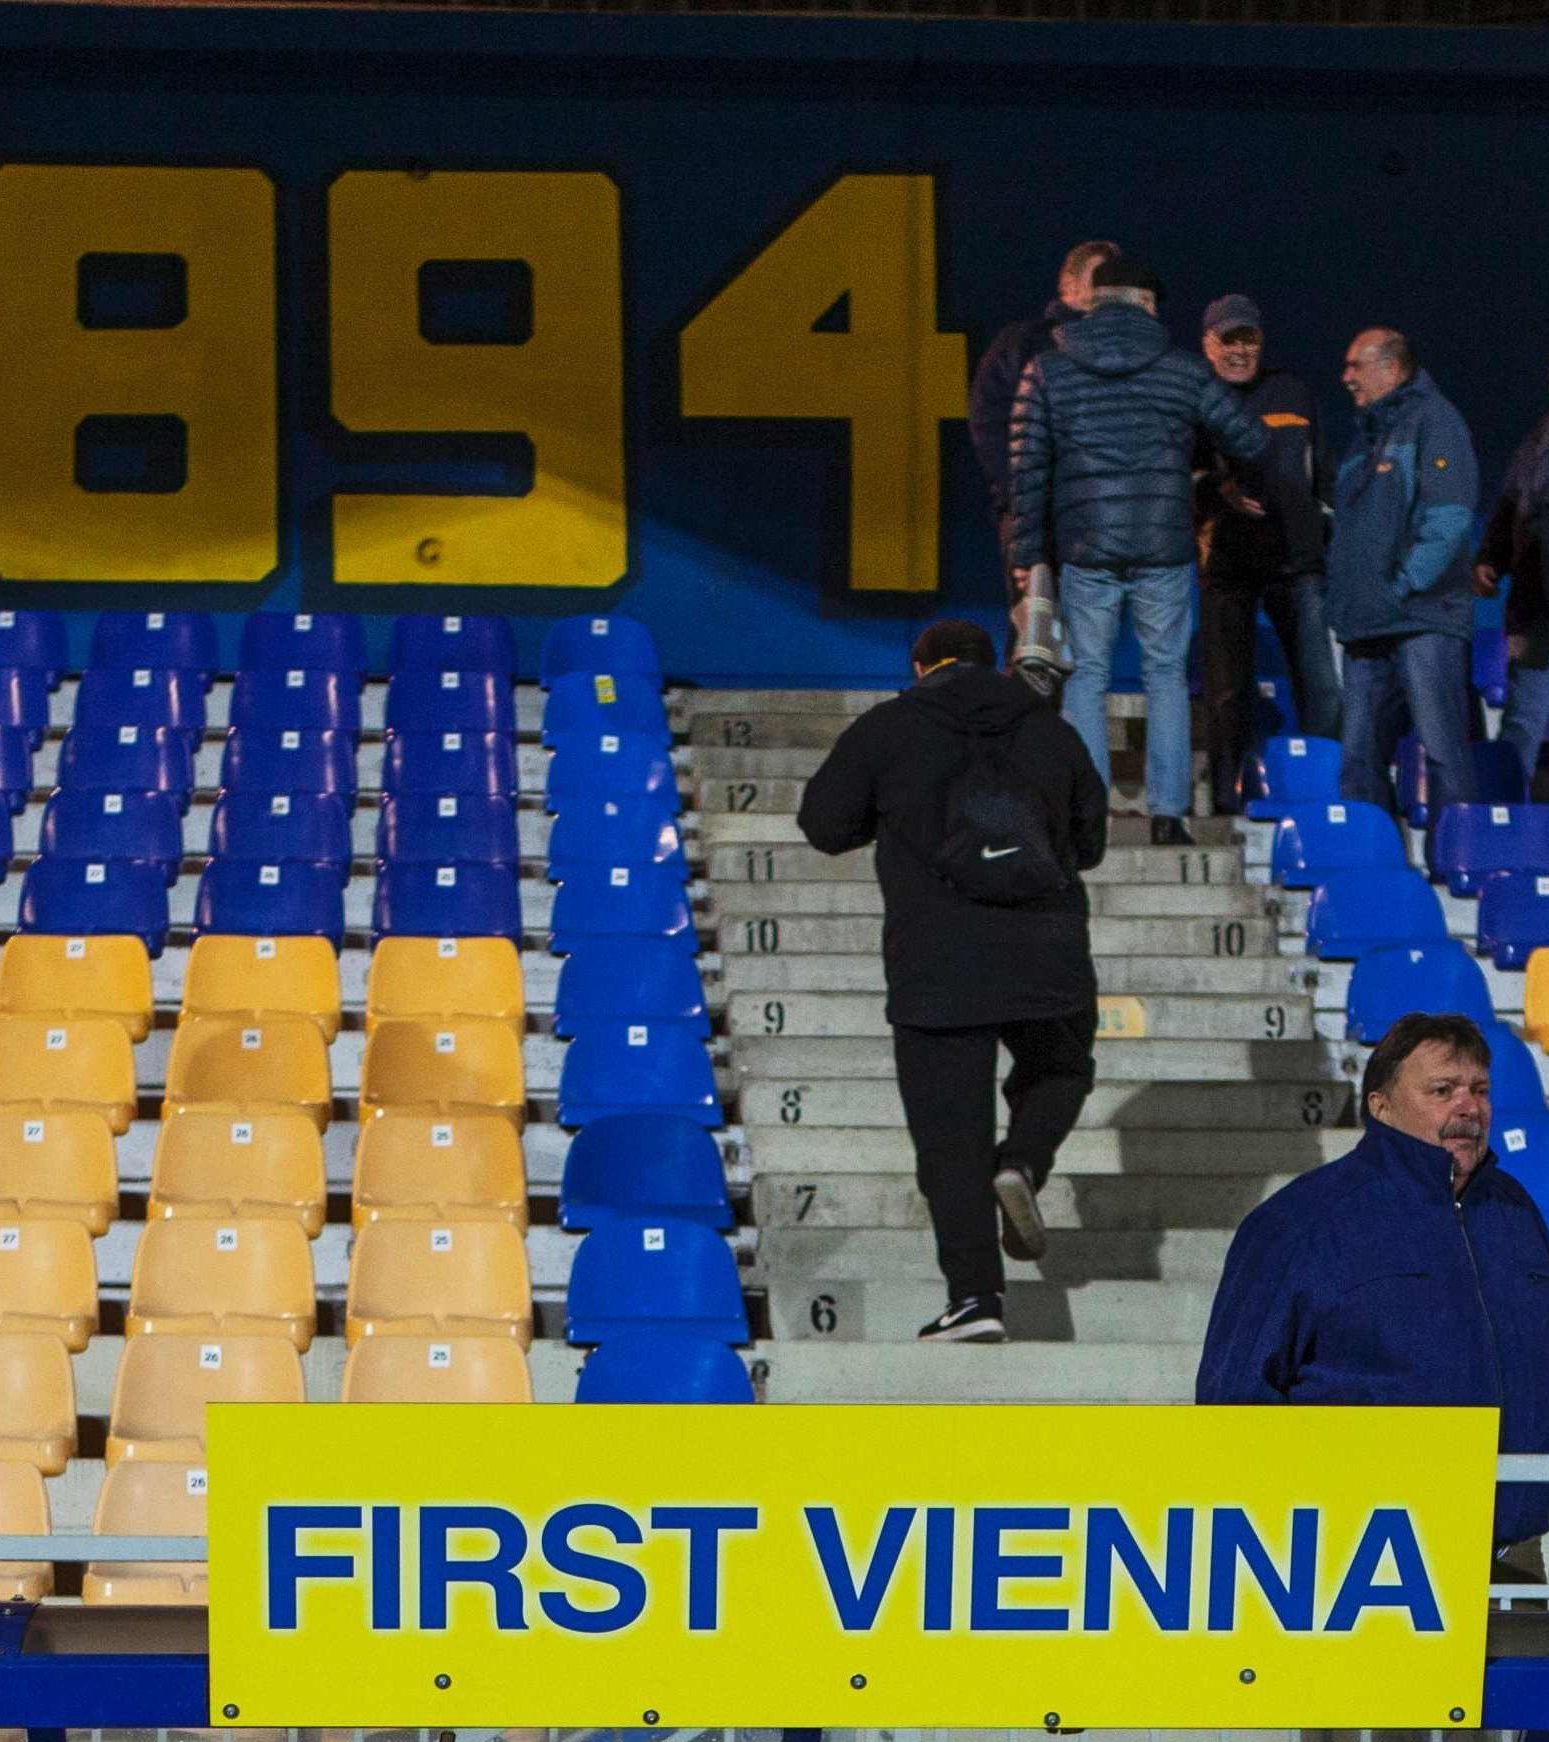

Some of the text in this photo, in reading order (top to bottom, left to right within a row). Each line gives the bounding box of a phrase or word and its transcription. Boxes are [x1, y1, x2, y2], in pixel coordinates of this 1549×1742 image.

[726, 783, 757, 813] 12
[745, 918, 781, 955] 10
[1212, 920, 1246, 958] 10
[763, 1001, 787, 1035] 9
[1264, 1005, 1286, 1039] 9
[779, 1089, 804, 1125] 8
[1302, 1090, 1323, 1126] 8
[794, 1184, 818, 1221] 7
[810, 1293, 838, 1335] 6
[266, 1502, 1446, 1633] FIRST VIENNA
